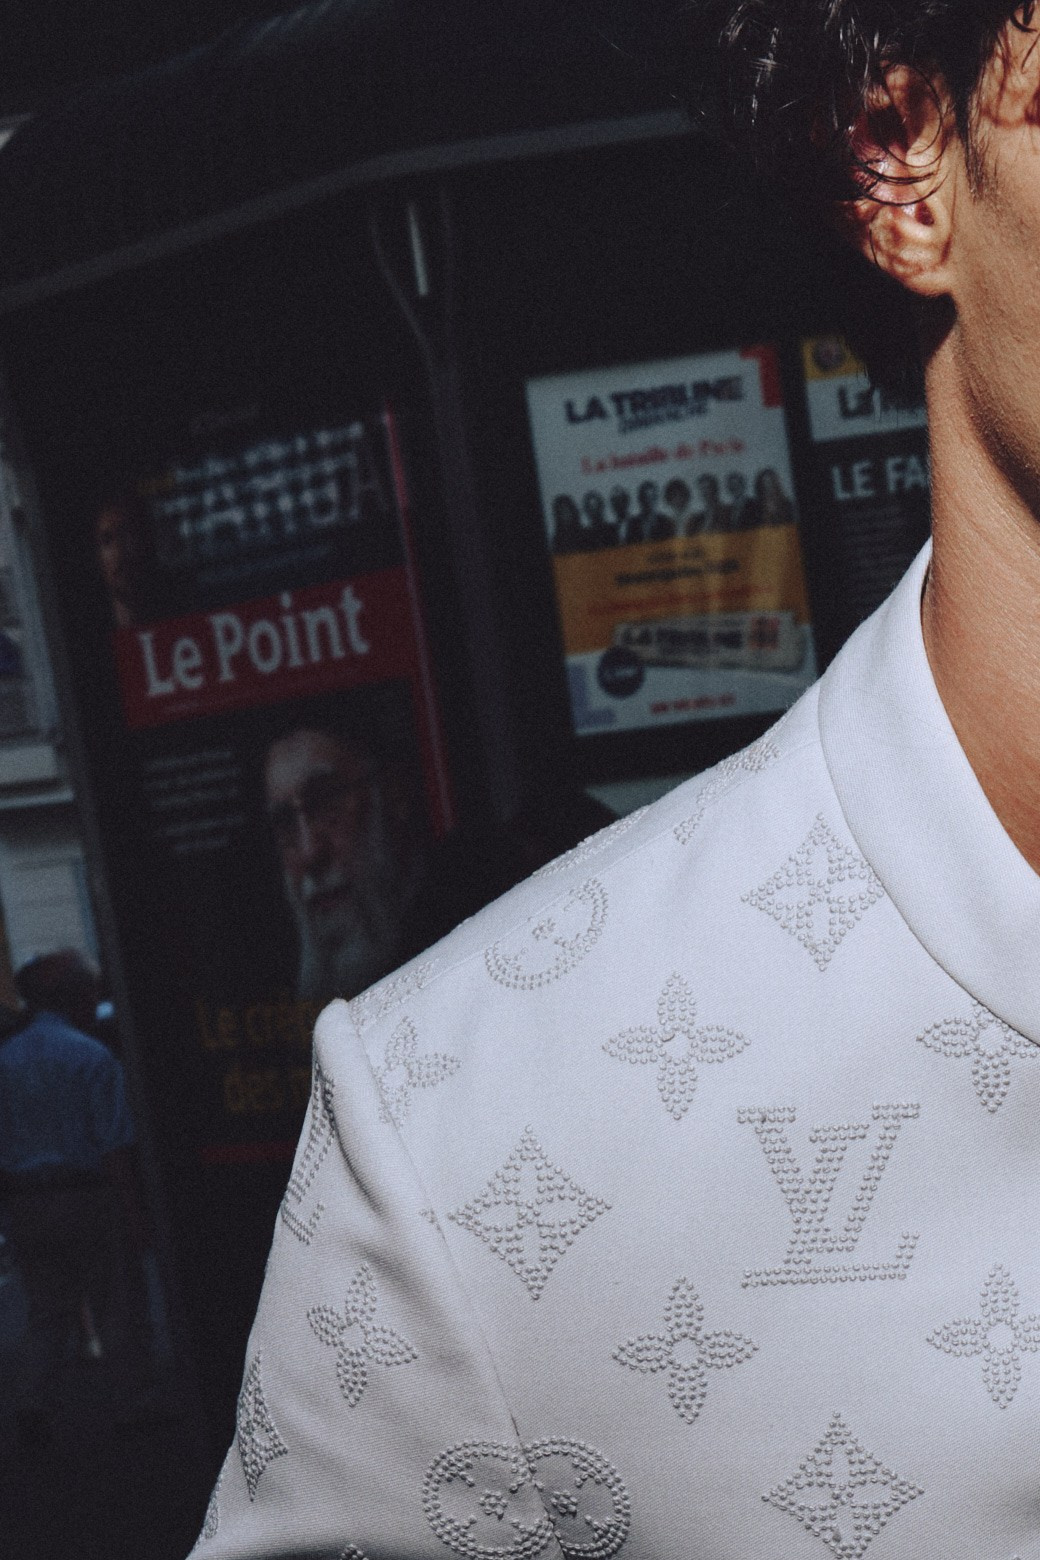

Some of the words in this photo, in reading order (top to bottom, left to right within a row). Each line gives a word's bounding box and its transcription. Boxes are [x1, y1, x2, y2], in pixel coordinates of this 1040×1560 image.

[565, 395, 607, 424] LA
[610, 375, 744, 415] TRIBUNE
[831, 459, 876, 500] LE
[137, 629, 205, 698] Le
[207, 584, 371, 683] Point
[736, 1101, 921, 1289] LV
